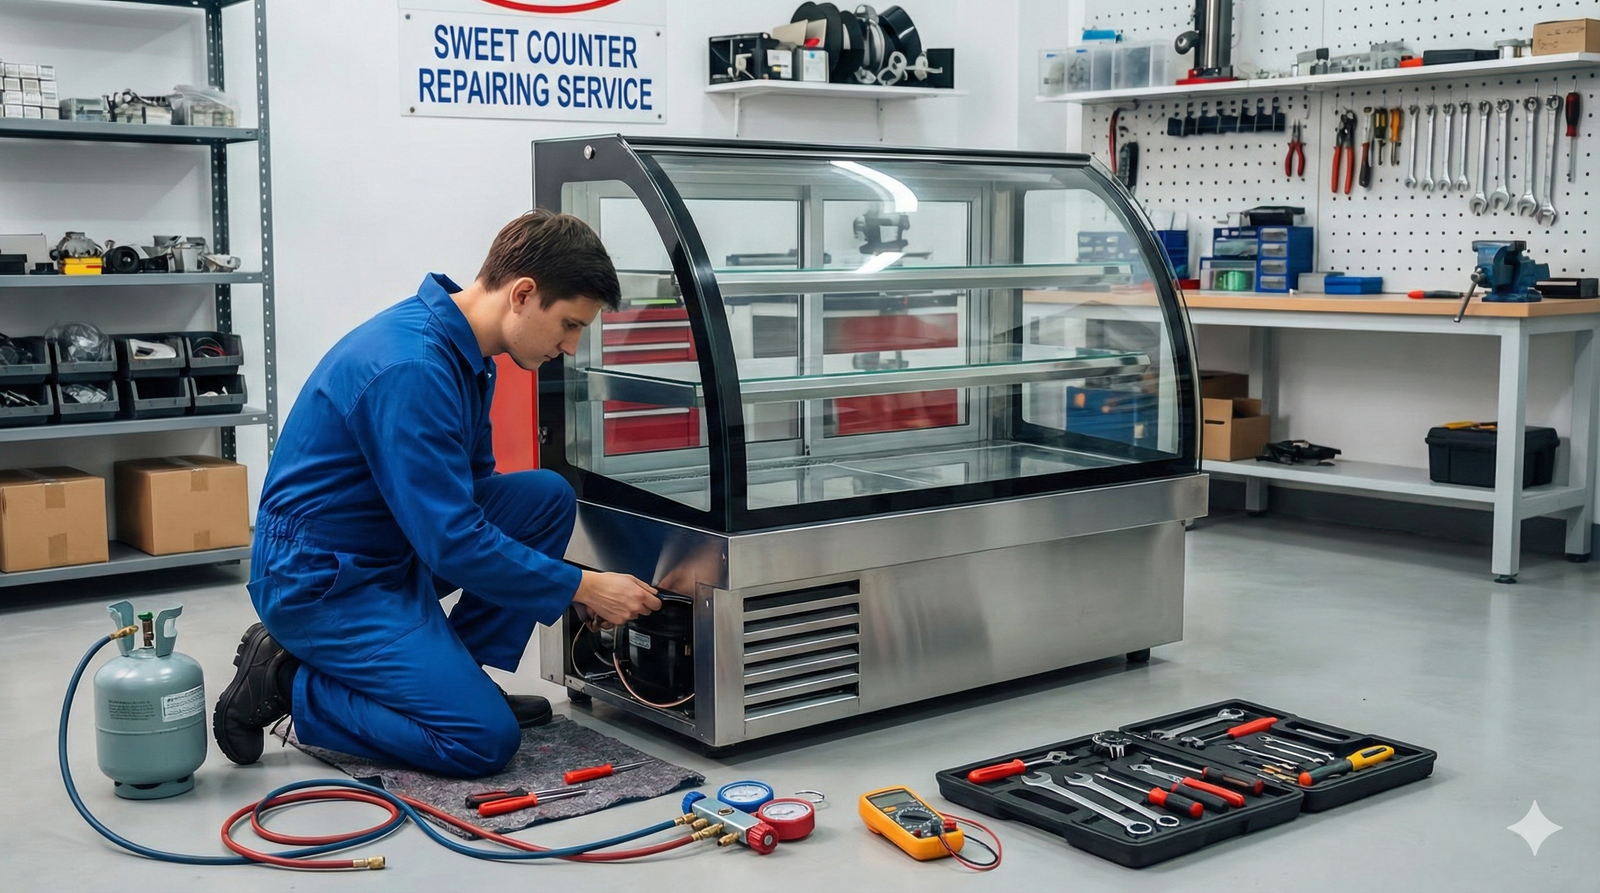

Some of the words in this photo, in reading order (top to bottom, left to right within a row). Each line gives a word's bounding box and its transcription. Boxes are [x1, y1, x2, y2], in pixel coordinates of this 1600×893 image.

[434, 24, 519, 62] SWEET
[527, 30, 638, 69] COUNTER
[418, 68, 550, 107] REPAIRING
[557, 74, 653, 111] SERVICE
